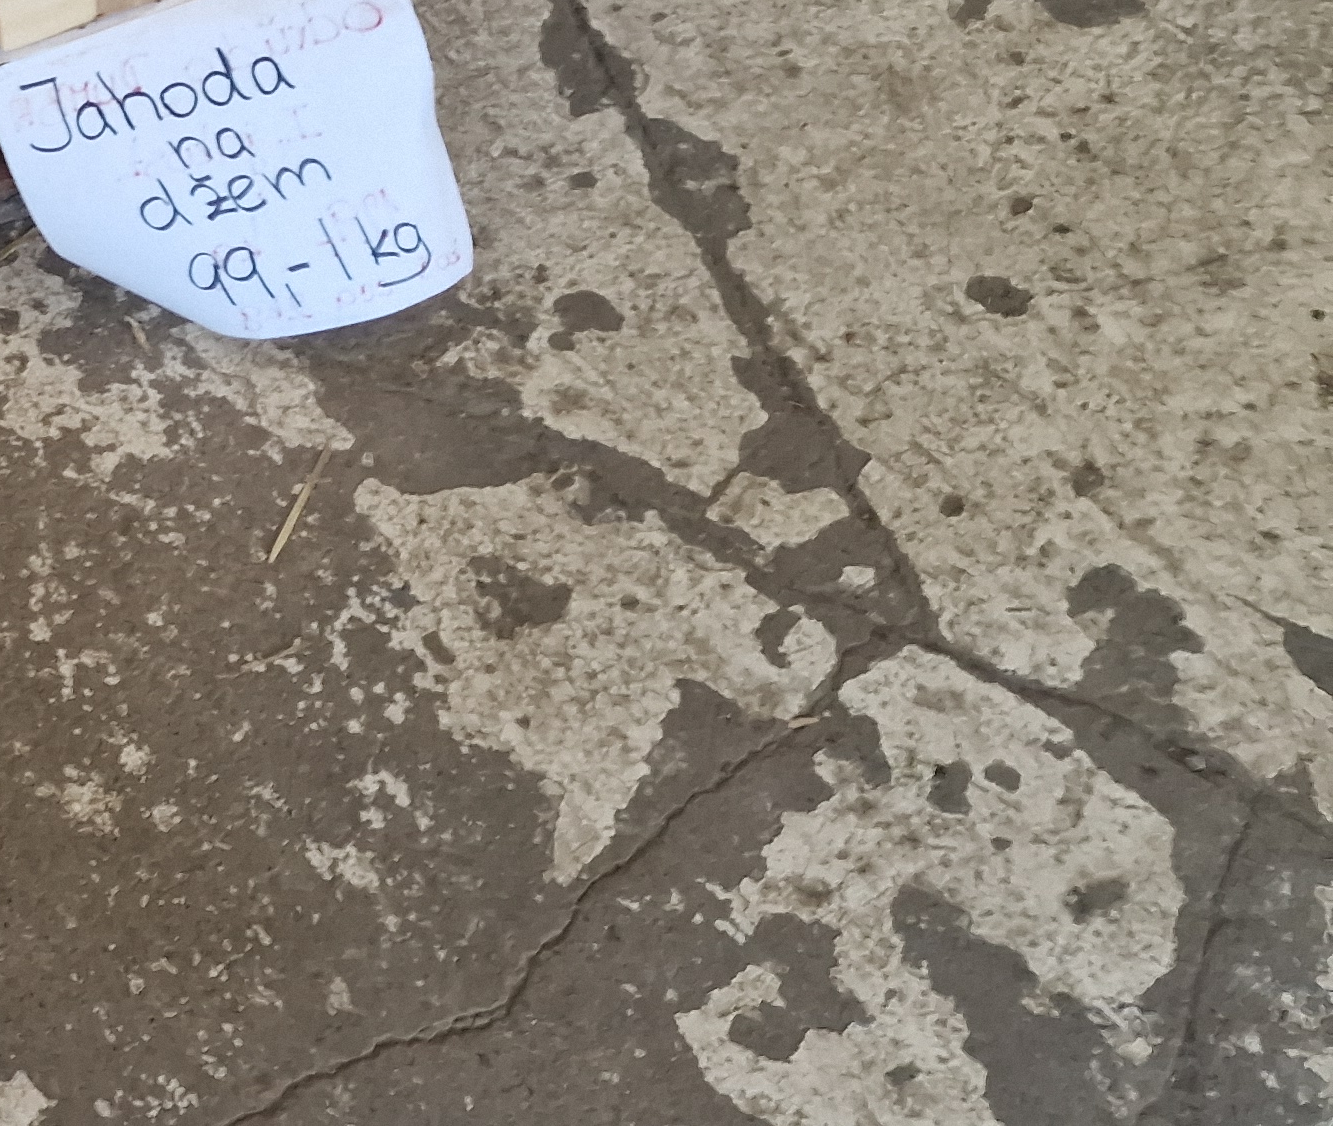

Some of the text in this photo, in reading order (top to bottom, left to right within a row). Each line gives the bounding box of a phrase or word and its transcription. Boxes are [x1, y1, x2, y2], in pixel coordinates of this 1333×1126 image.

[20, 47, 296, 153] Jahoda
[168, 126, 255, 169] na
[139, 157, 332, 232] džem
